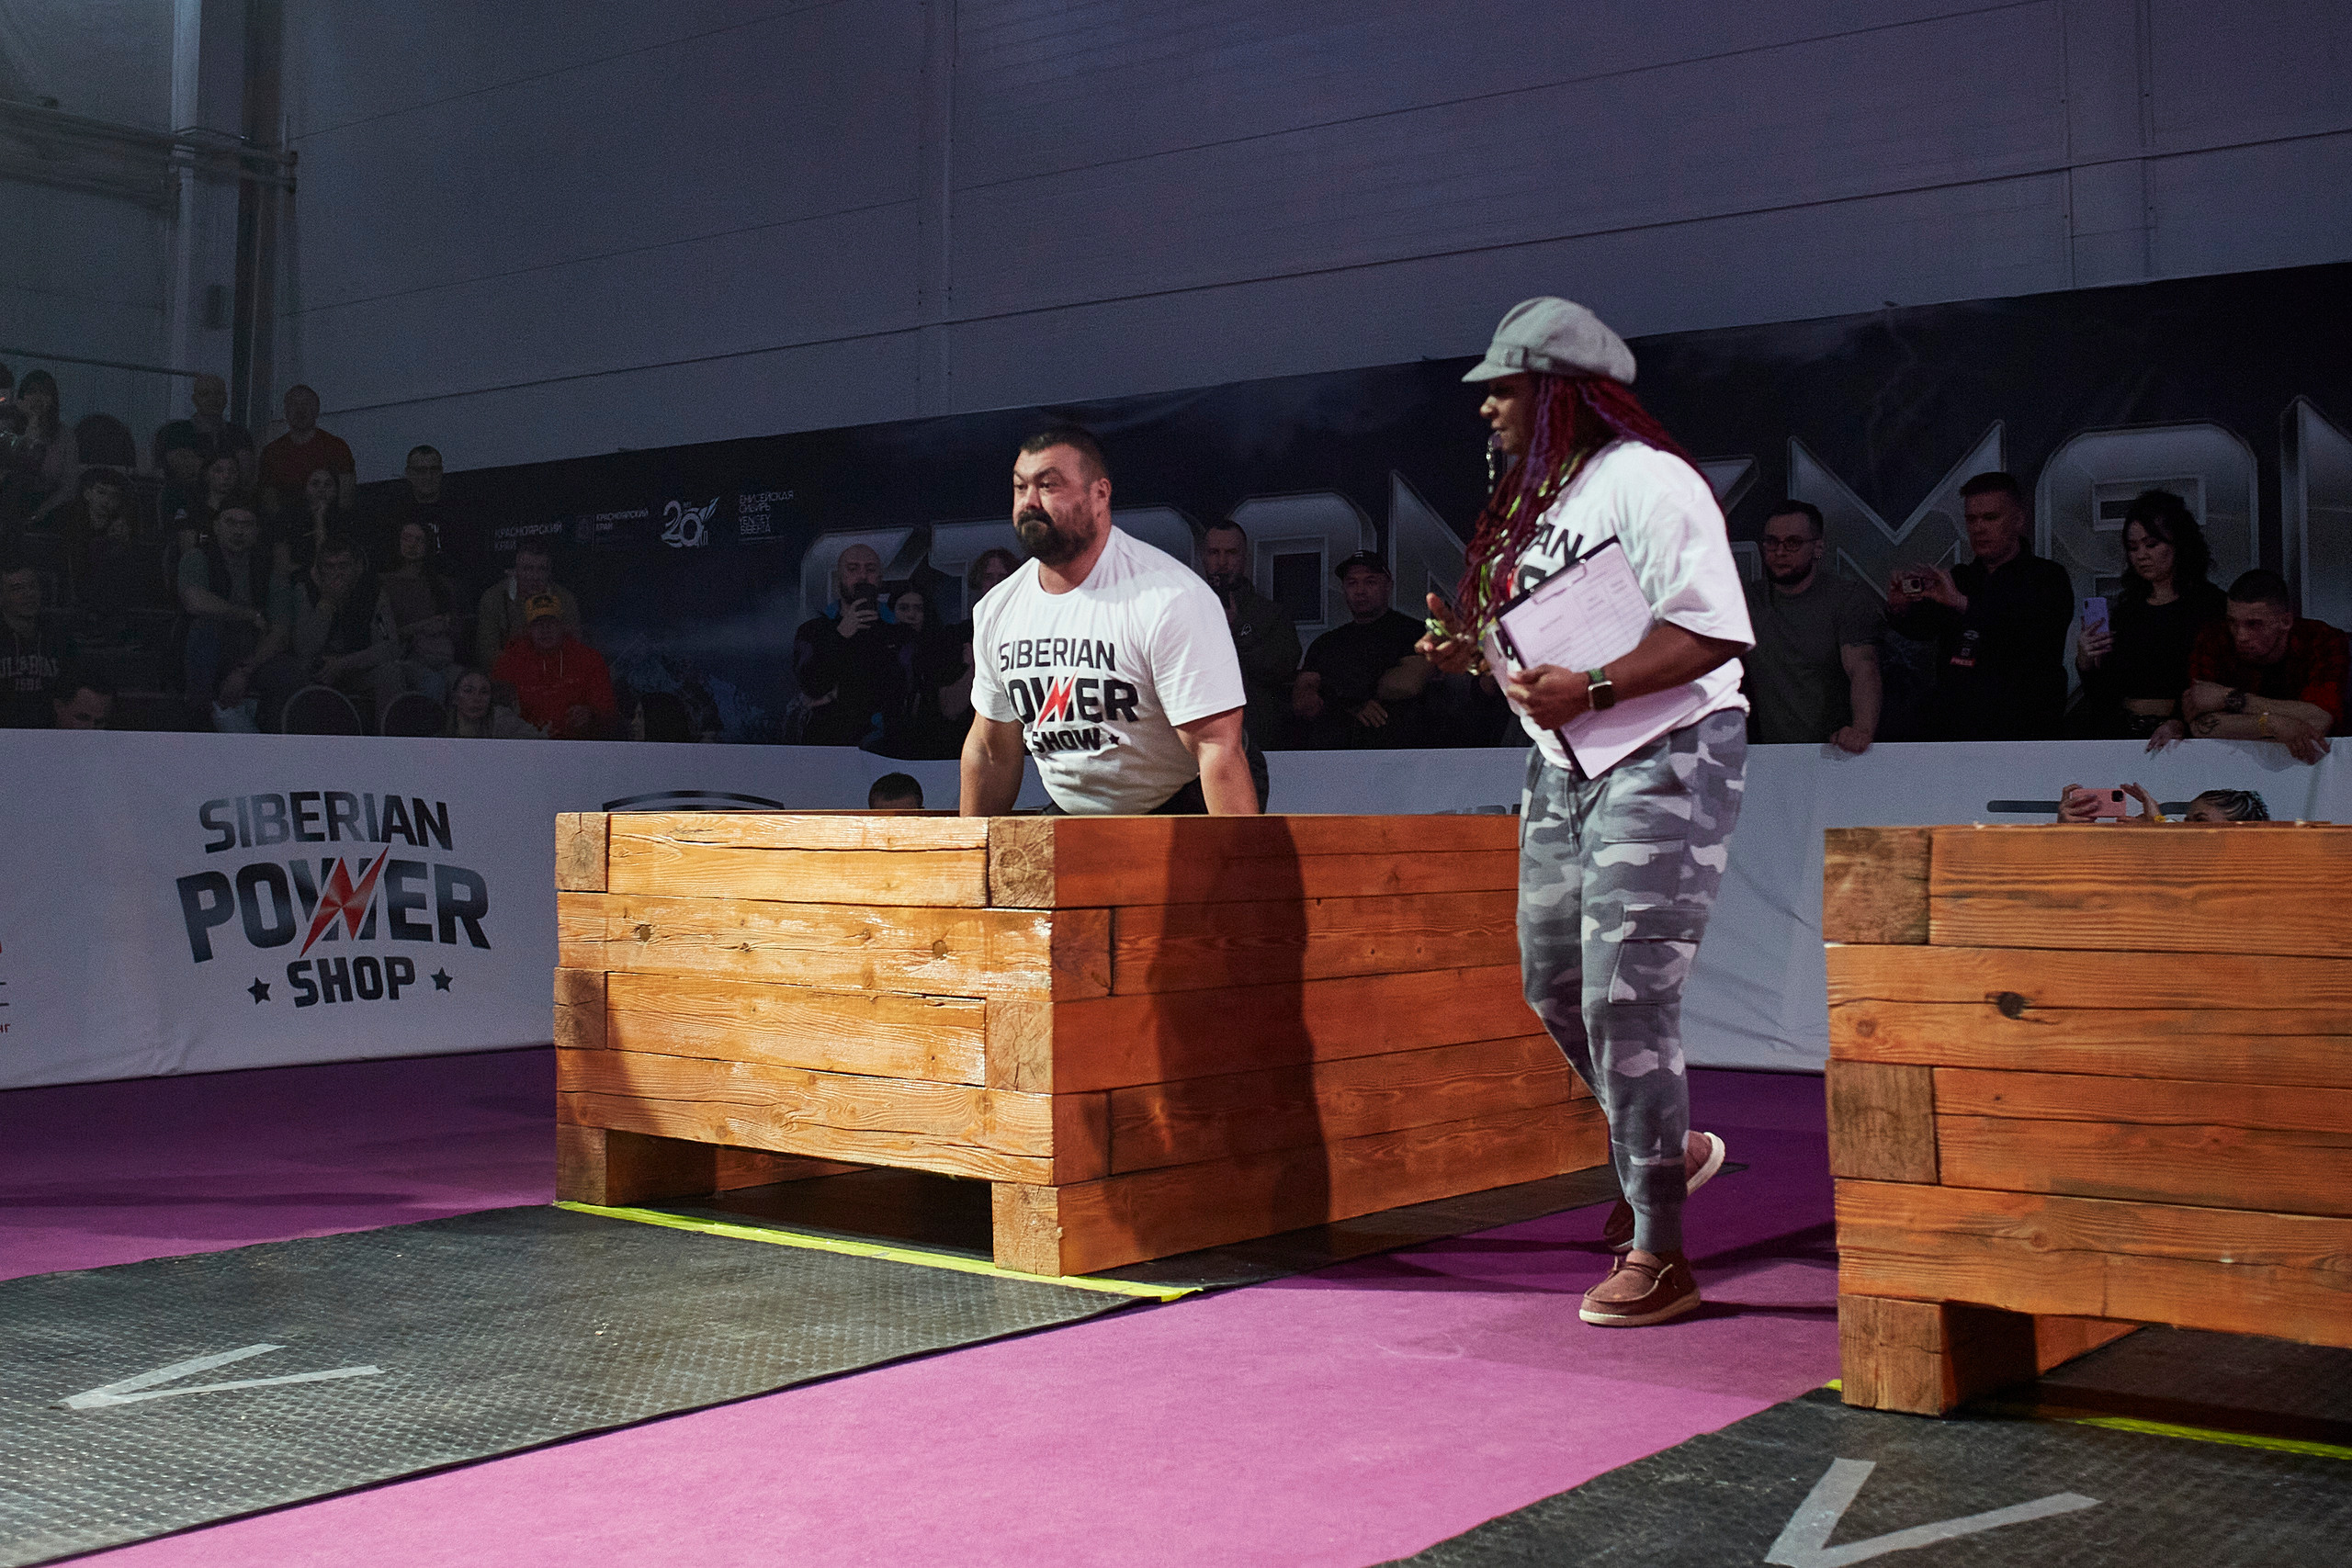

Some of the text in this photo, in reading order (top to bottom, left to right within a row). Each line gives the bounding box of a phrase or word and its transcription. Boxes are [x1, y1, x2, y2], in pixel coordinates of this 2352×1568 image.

[999, 638, 1116, 672] SIBERIAN
[1007, 676, 1139, 726] OWER
[1033, 728, 1102, 753] SHOW
[198, 790, 454, 854] SIBERIAN
[175, 849, 492, 964] POWER
[286, 955, 416, 1009] SHOP
